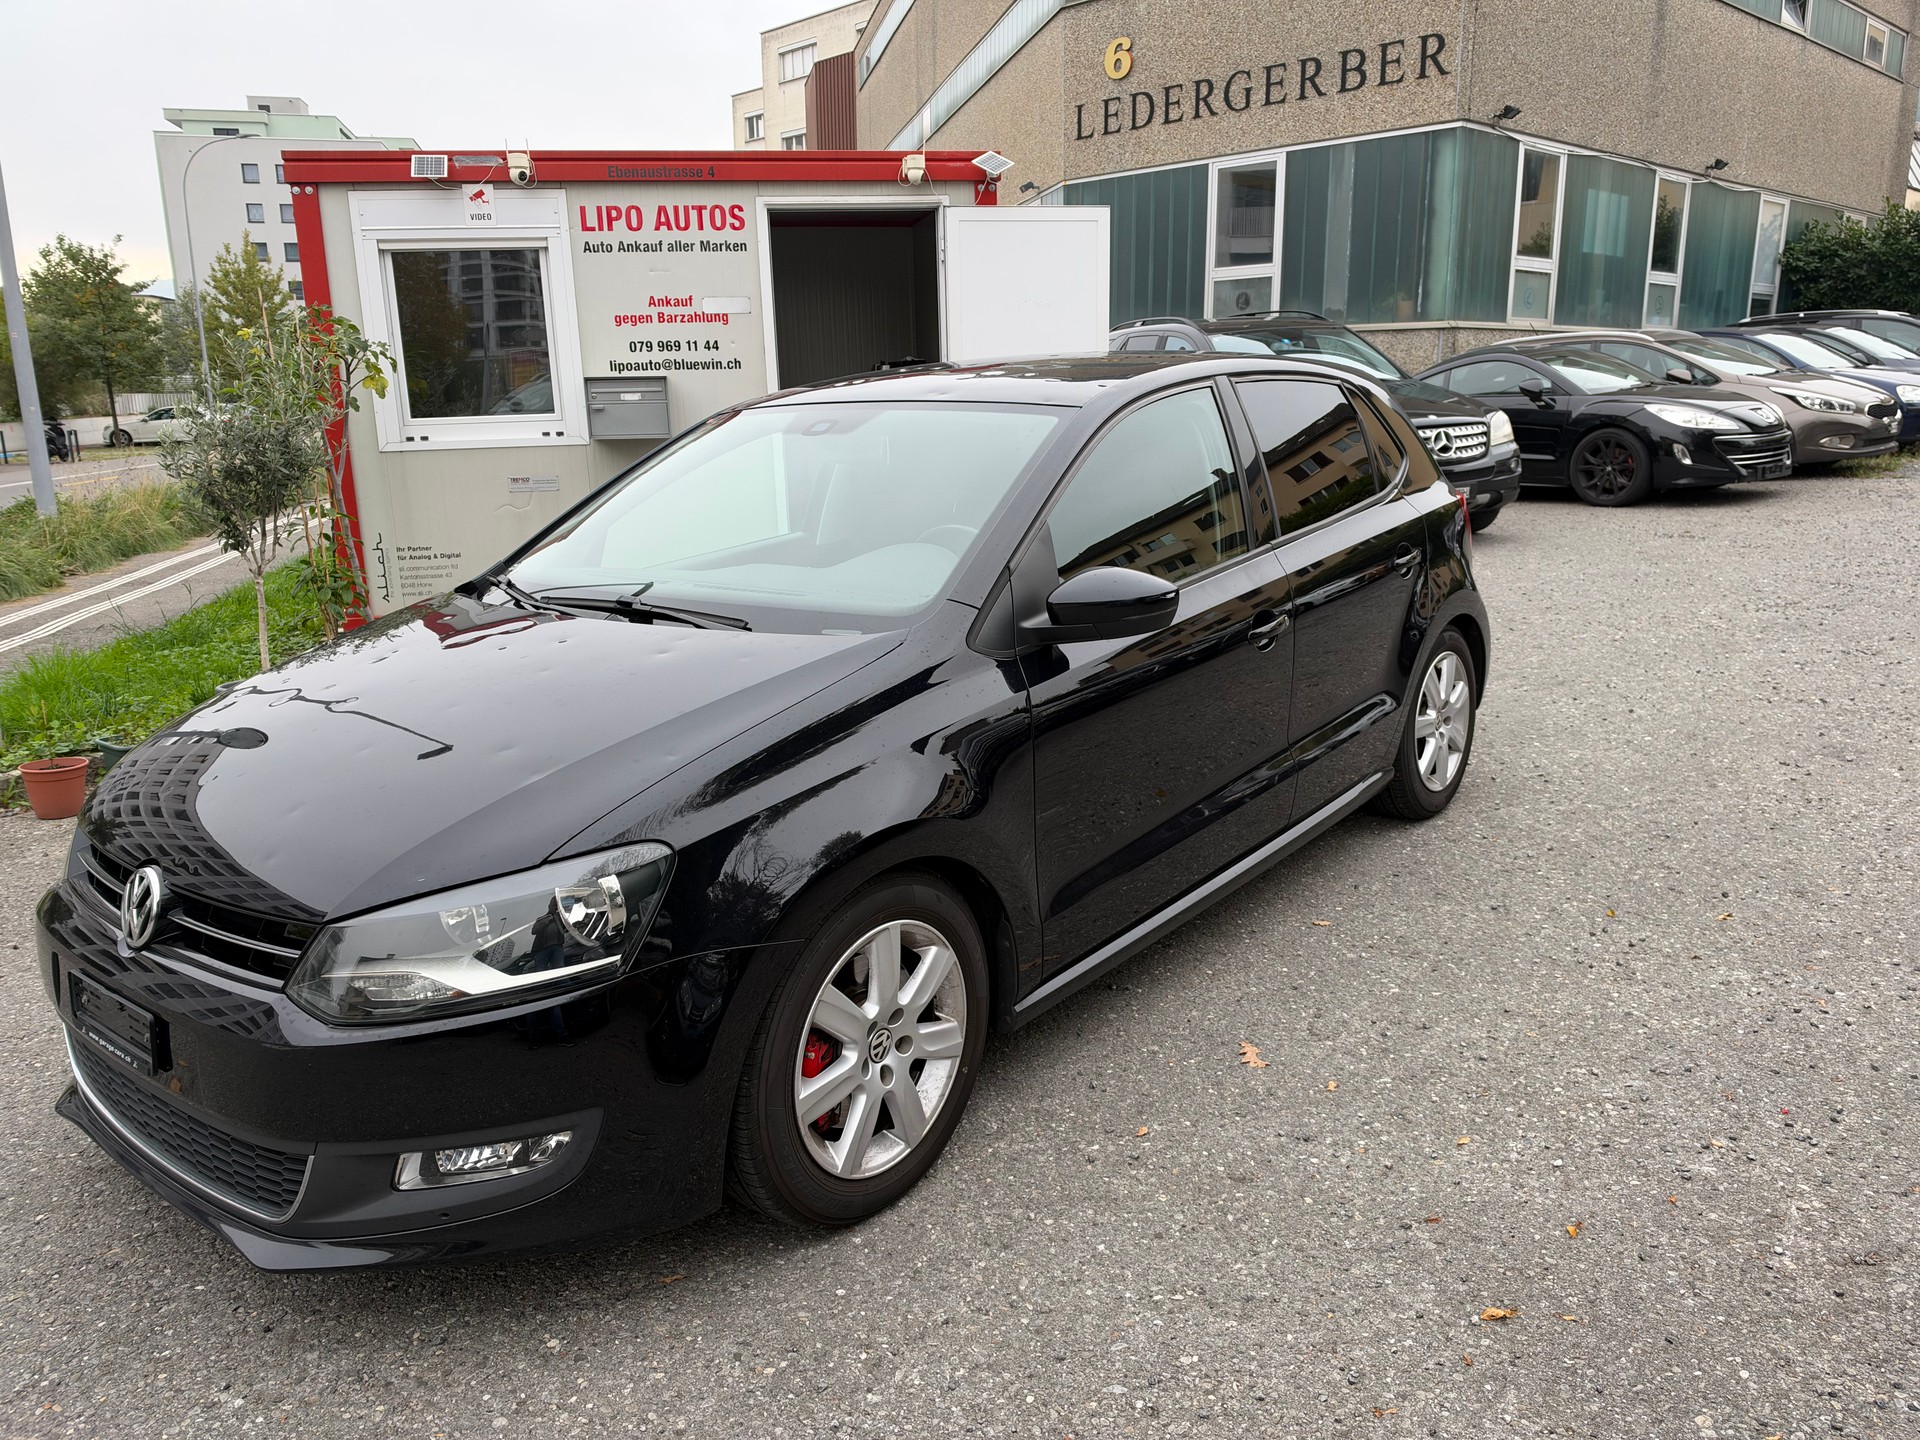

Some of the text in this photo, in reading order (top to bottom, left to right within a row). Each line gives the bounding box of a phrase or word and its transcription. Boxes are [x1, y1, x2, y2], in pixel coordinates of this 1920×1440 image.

[1104, 36, 1133, 80] 6
[1074, 32, 1450, 140] LEDERGERBER
[607, 165, 716, 179] Ebenaustrasse 4
[469, 212, 492, 221] VIDEO
[579, 204, 746, 232] LIPO AUTOS
[583, 239, 748, 254] Auto Ankauf aller Marken
[648, 295, 693, 308] Ankauf
[614, 311, 729, 327] gegen Barzahlung
[629, 339, 720, 353] 079 969 11 44
[609, 358, 742, 375] lipoauto@bluewin.ch
